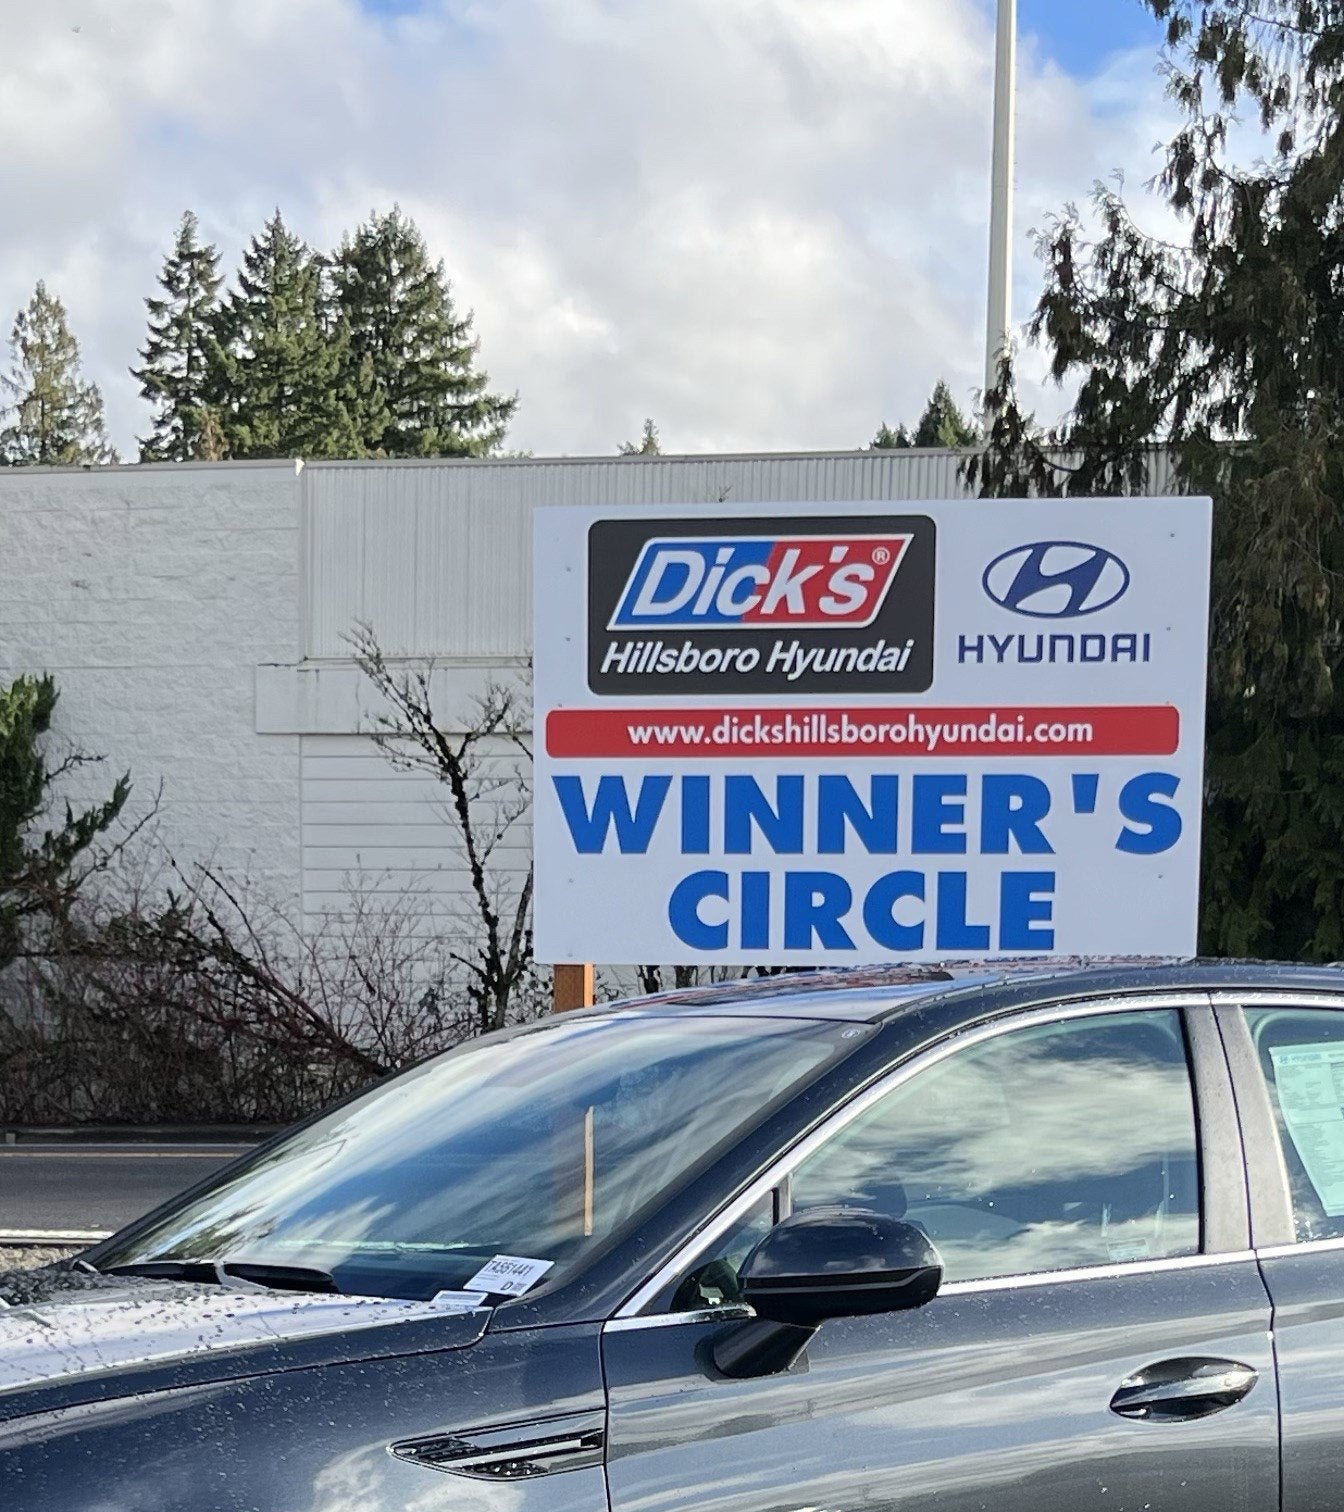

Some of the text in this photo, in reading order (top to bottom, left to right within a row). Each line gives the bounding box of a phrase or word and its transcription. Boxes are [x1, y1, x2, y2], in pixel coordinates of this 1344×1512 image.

[631, 545, 875, 617] Dick's
[600, 638, 915, 681] Hillsboro Hyundai
[959, 633, 1150, 664] HYUNDAI
[628, 713, 1094, 752] www.dickshillsborohyundai.com
[551, 771, 1183, 856] WINNER'S
[667, 869, 1056, 952] CIRCLE
